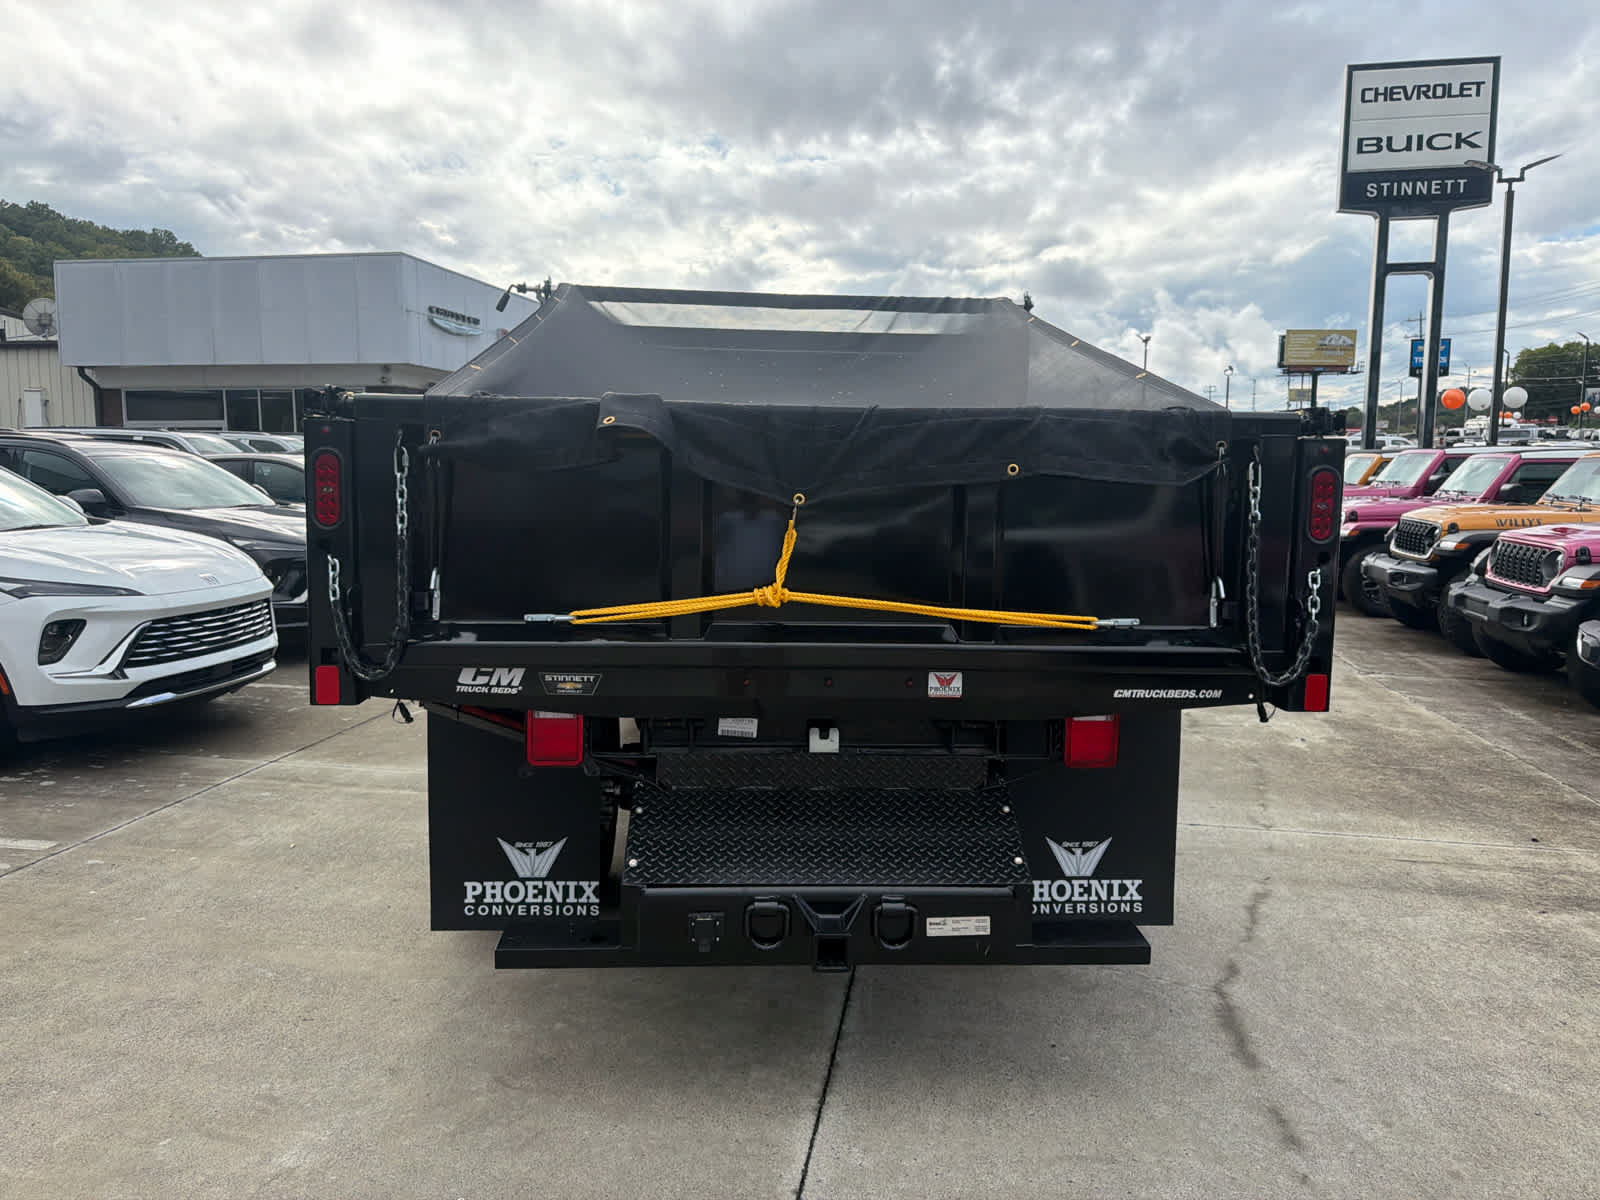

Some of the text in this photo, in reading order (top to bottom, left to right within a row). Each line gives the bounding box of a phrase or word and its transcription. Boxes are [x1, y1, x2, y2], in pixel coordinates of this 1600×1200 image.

[1360, 81, 1486, 103] CHEVROLET
[1356, 130, 1483, 155] BUICK
[1366, 179, 1468, 198] STINNETT
[1496, 518, 1544, 527] WILLYS
[544, 674, 595, 682] STINNETT
[456, 685, 489, 694] TRUCK
[1113, 689, 1222, 699] CMTRUCKBEDS.COM
[464, 881, 600, 903] PHOENIX
[1032, 879, 1143, 902] HOENIX
[464, 905, 600, 916] CONVERSIONS
[1032, 902, 1143, 914] ONVERSIONS
